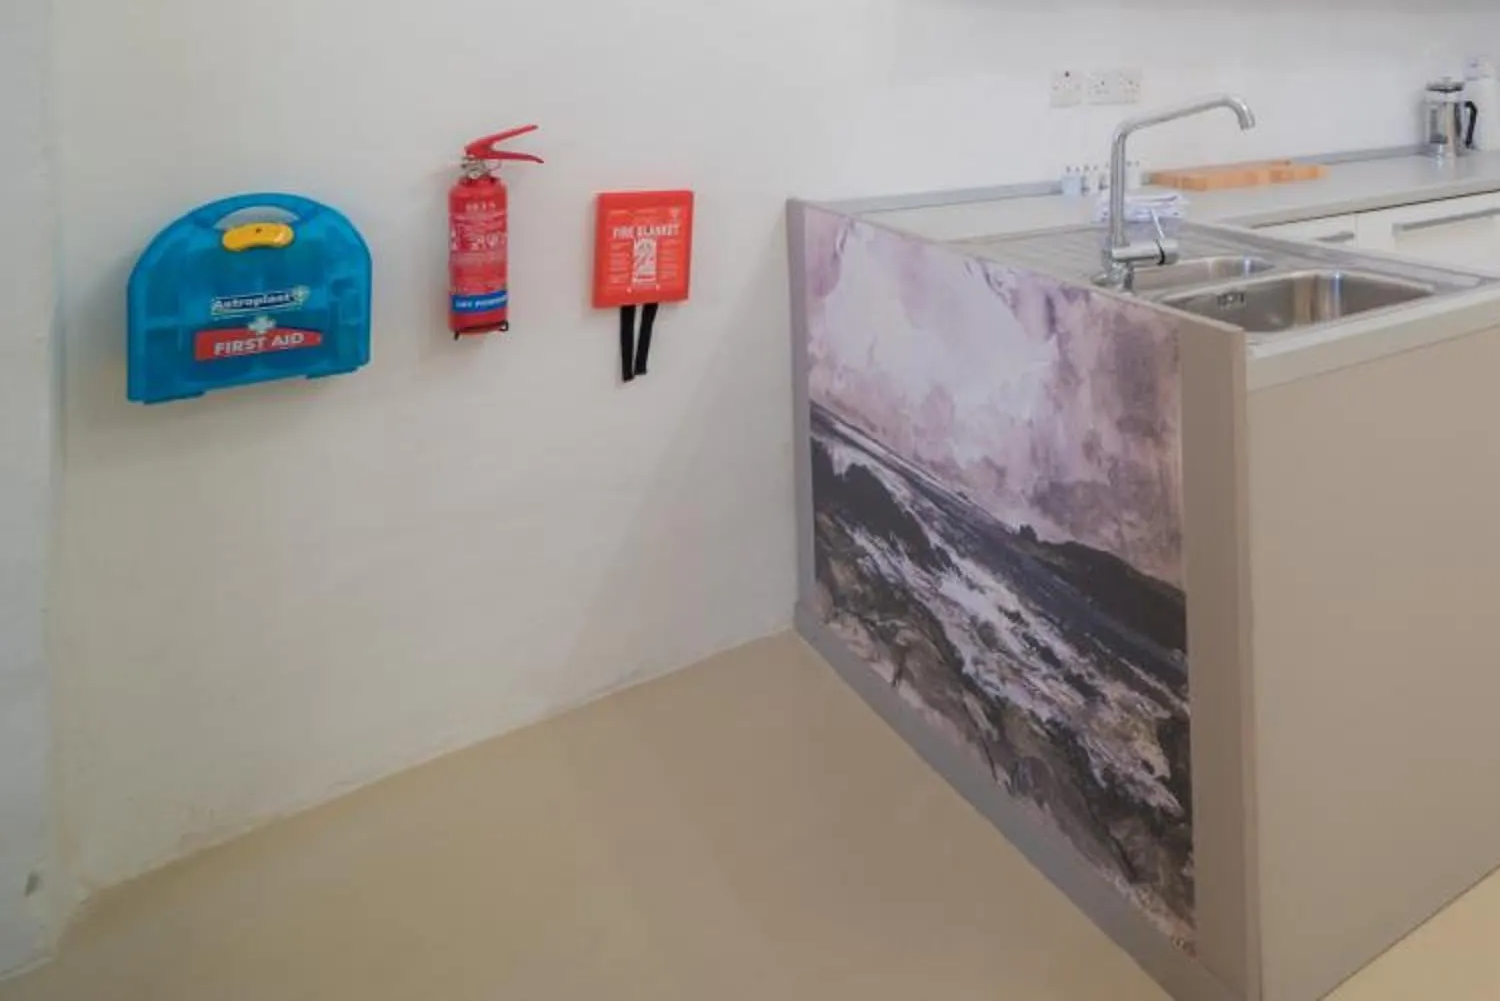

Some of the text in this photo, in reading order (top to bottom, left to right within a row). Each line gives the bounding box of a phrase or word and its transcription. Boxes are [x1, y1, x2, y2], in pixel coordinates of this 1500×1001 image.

[613, 222, 679, 240] FIRE BLANKET
[212, 293, 290, 308] Astroplast
[214, 332, 305, 356] FIRST AID
